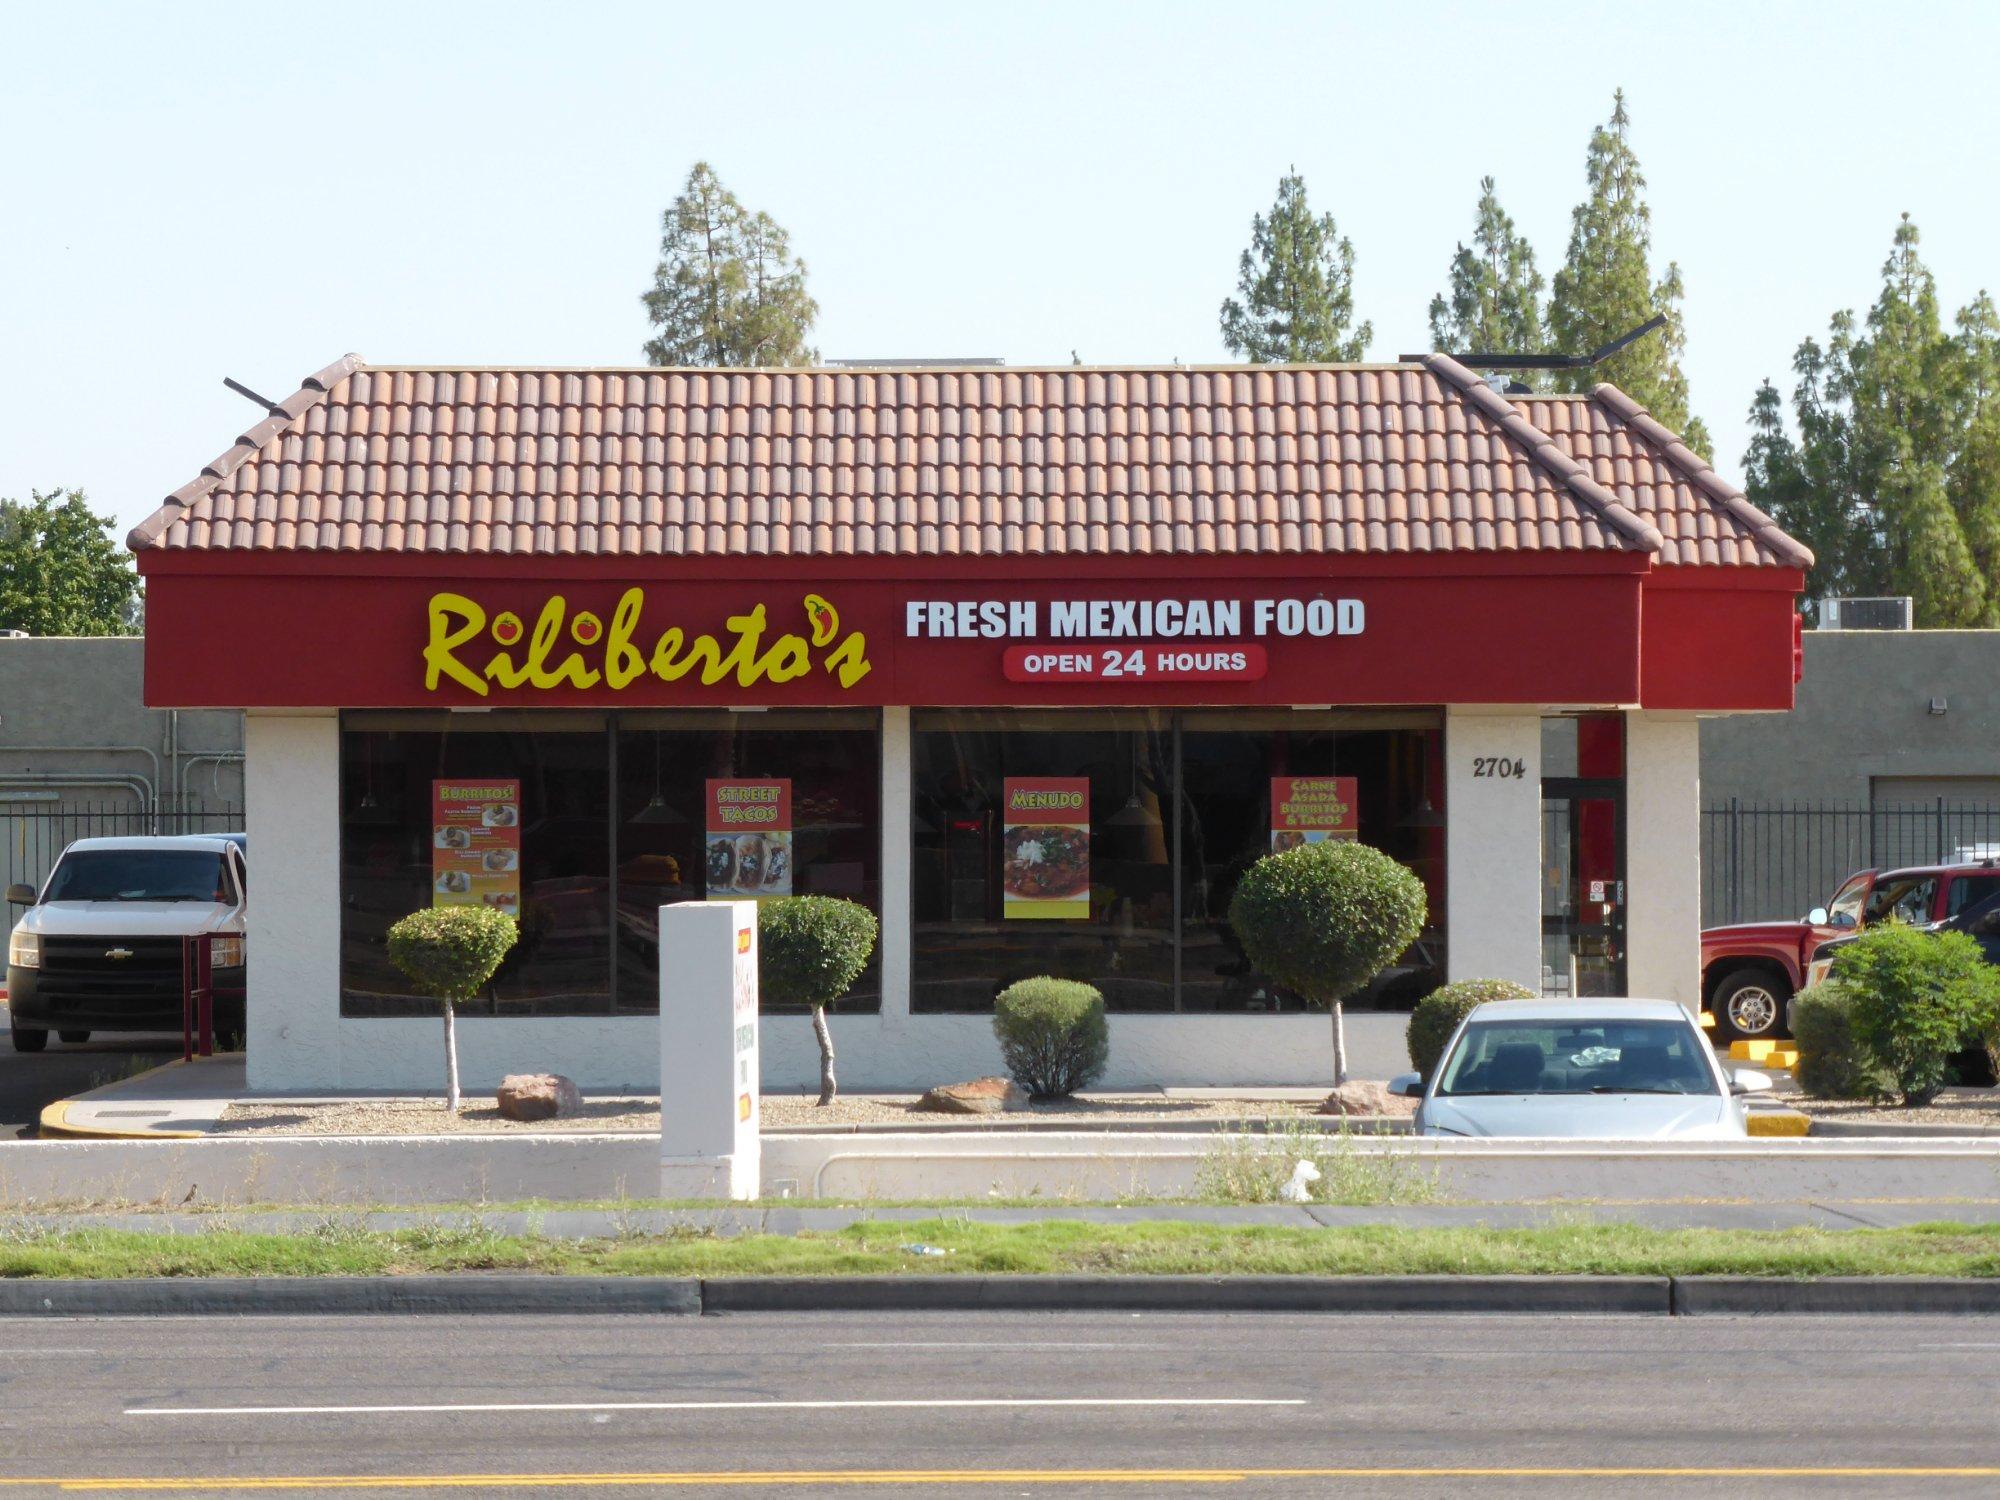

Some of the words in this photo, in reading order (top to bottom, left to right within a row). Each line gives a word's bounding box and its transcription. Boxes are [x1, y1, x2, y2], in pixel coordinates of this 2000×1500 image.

[906, 601, 1037, 637] FRESH
[1050, 600, 1241, 637] MEXICAN
[1254, 599, 1366, 636] FOOD
[423, 587, 872, 697] Riliberto's
[1024, 654, 1093, 673] OPEN
[1101, 650, 1146, 676] 24
[1157, 652, 1247, 671] HOURS
[1473, 758, 1526, 779] 2704
[1291, 780, 1336, 791] CARNE
[717, 786, 780, 803] STREET
[1010, 788, 1084, 810] MENUDO
[1291, 792, 1337, 803] ASADA
[719, 806, 778, 823] TACOS
[1281, 803, 1348, 814] BURRITOS
[1300, 814, 1342, 824] TACOS
